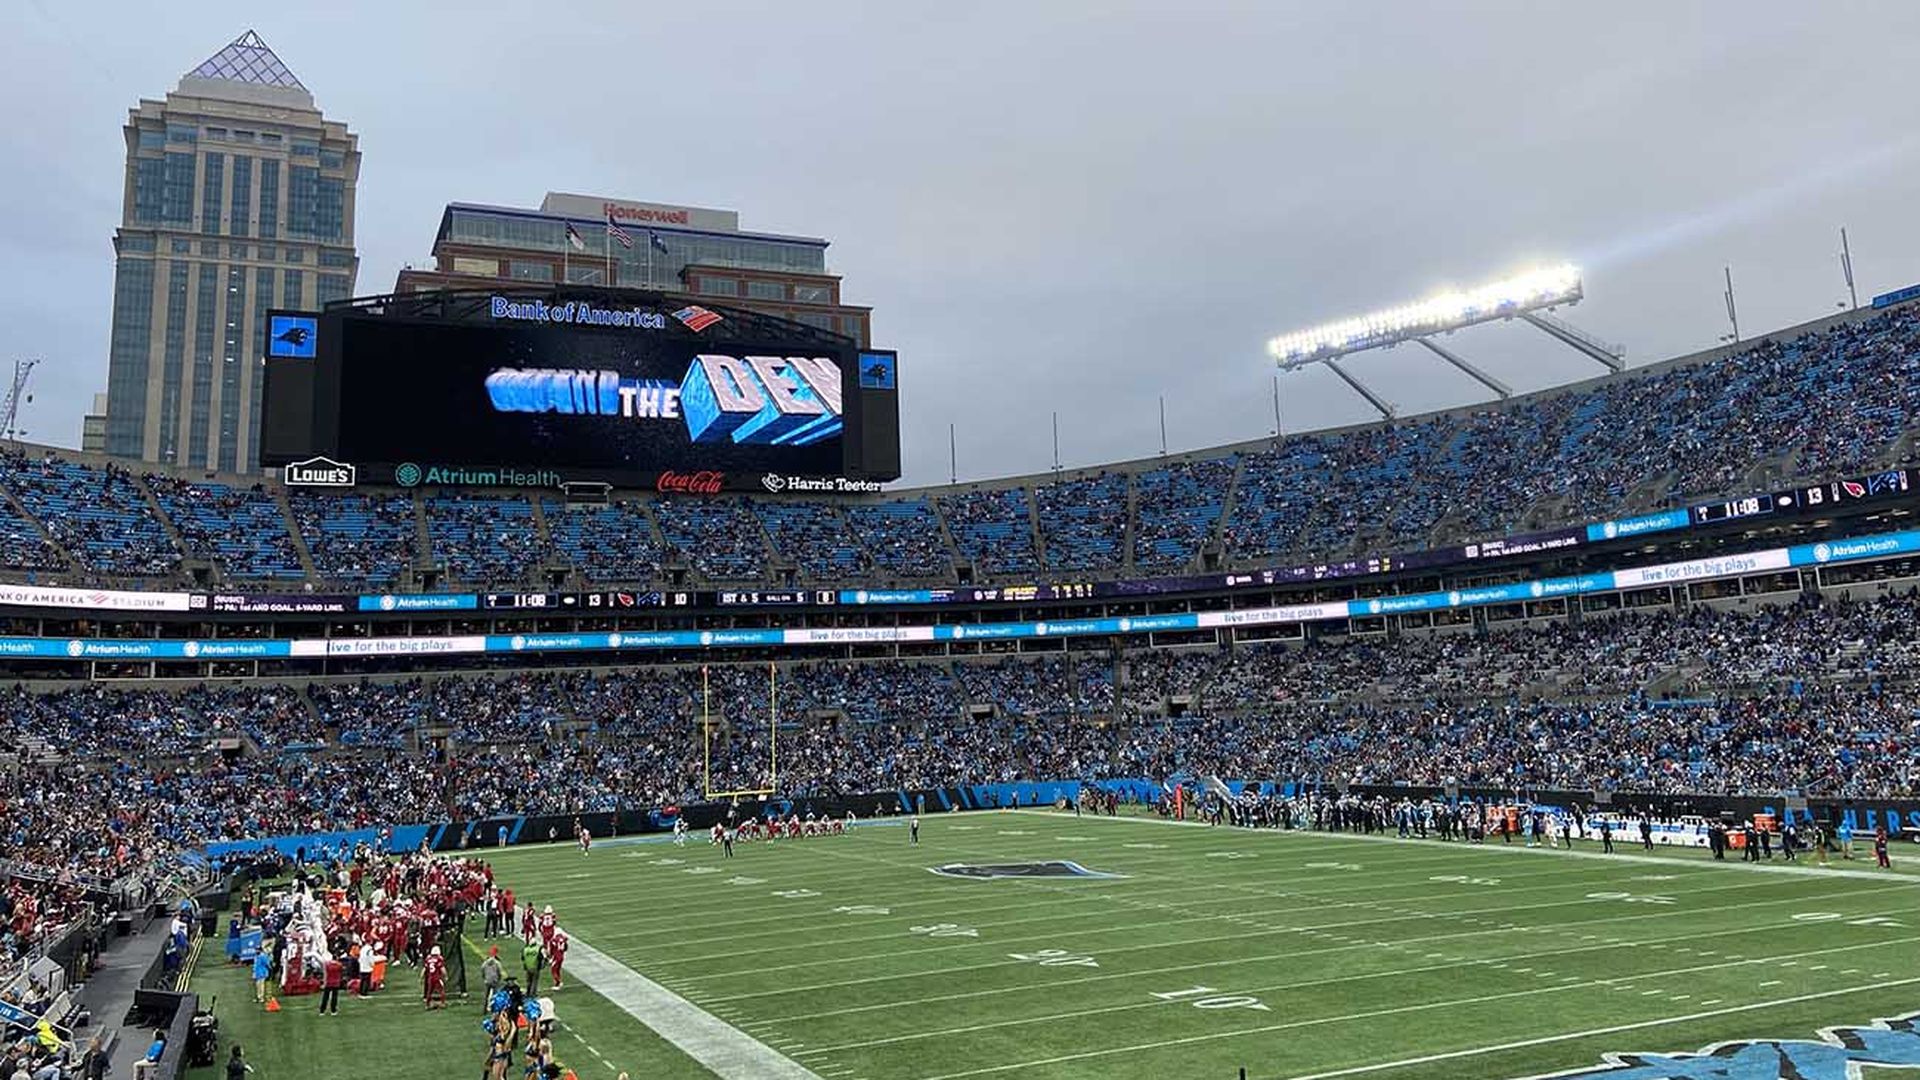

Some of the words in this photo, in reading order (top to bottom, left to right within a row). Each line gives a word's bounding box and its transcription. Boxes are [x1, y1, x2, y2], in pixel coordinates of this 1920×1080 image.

[603, 203, 689, 224] Honeywell
[491, 297, 550, 320] Bank
[551, 303, 575, 322] of
[576, 302, 665, 329] America
[619, 387, 680, 417] THE
[425, 467, 496, 485] Atrium
[500, 469, 561, 487] Health
[787, 476, 833, 490] Harris
[835, 478, 881, 493] Teeter
[1807, 487, 1823, 505] 13
[1724, 498, 1760, 518] 11:08
[1618, 520, 1646, 533] Atrium
[1833, 545, 1866, 556] Atrium
[1866, 540, 1899, 551] Health
[1642, 569, 1662, 581] live
[1665, 567, 1681, 578] for
[1683, 564, 1700, 576] the
[1704, 562, 1722, 574] big
[1725, 558, 1756, 572] plays
[33, 595, 84, 604] AMERICA
[113, 598, 165, 606] STADIUM
[514, 594, 546, 606] 11:08
[589, 595, 600, 606] 13
[674, 594, 687, 605] 10
[751, 593, 759, 603] 5
[796, 592, 804, 603] 5
[1224, 613, 1243, 623] live
[1246, 612, 1259, 622] for
[1262, 611, 1278, 620] the
[201, 643, 235, 654] Atrium
[235, 644, 266, 654] Health
[354, 641, 372, 651] for
[376, 640, 396, 650] the
[400, 641, 418, 652] big
[421, 640, 453, 652] plays
[527, 638, 556, 647] Atrium
[85, 643, 123, 654] Atrium
[122, 645, 151, 655] Health
